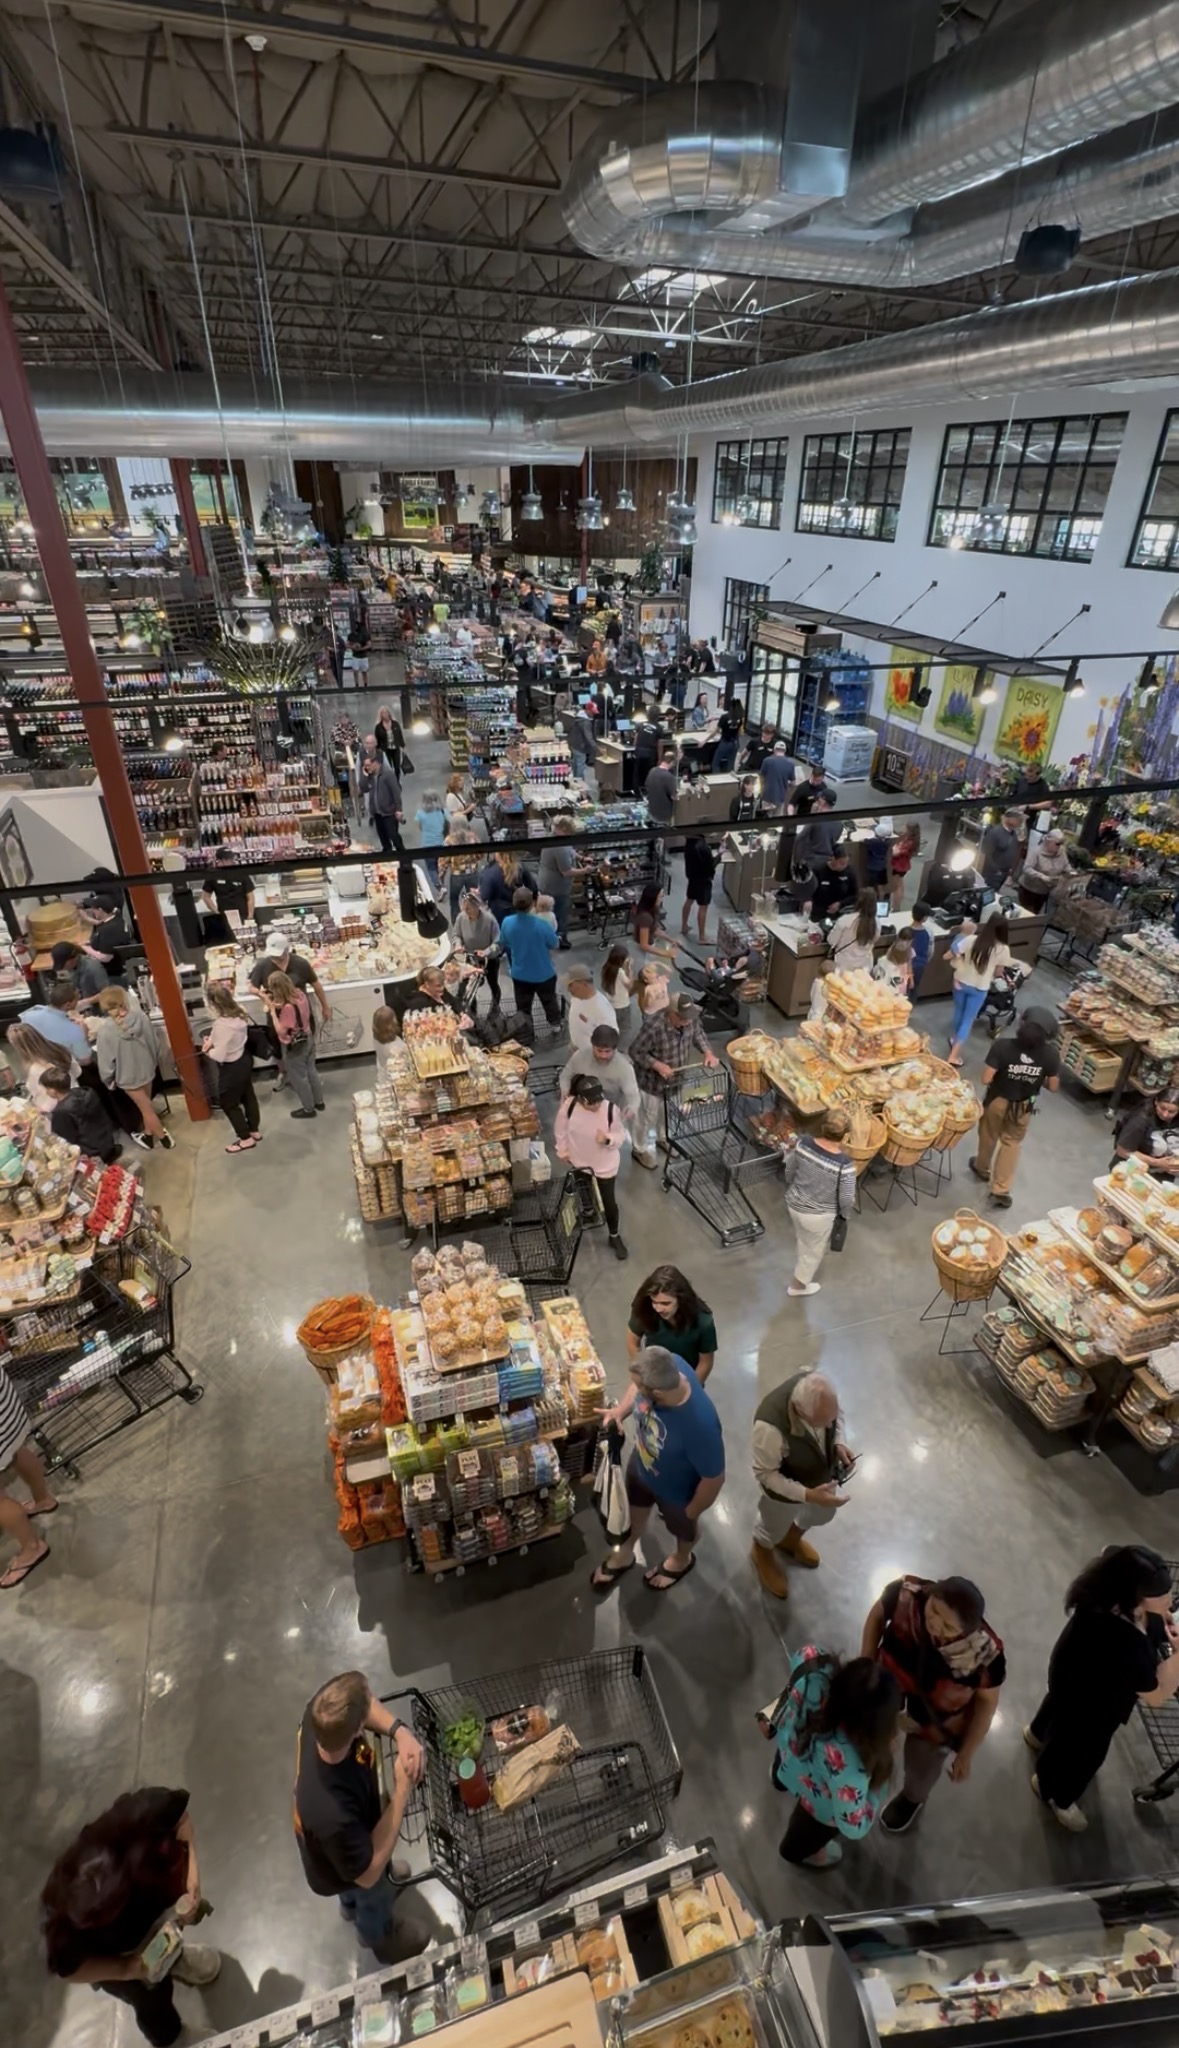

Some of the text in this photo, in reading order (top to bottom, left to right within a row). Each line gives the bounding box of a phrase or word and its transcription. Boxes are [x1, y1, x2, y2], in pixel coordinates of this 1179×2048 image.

[1016, 687, 1049, 709] DAISY
[886, 753, 897, 772] 10
[1008, 1064, 1042, 1075] SQUEEZE
